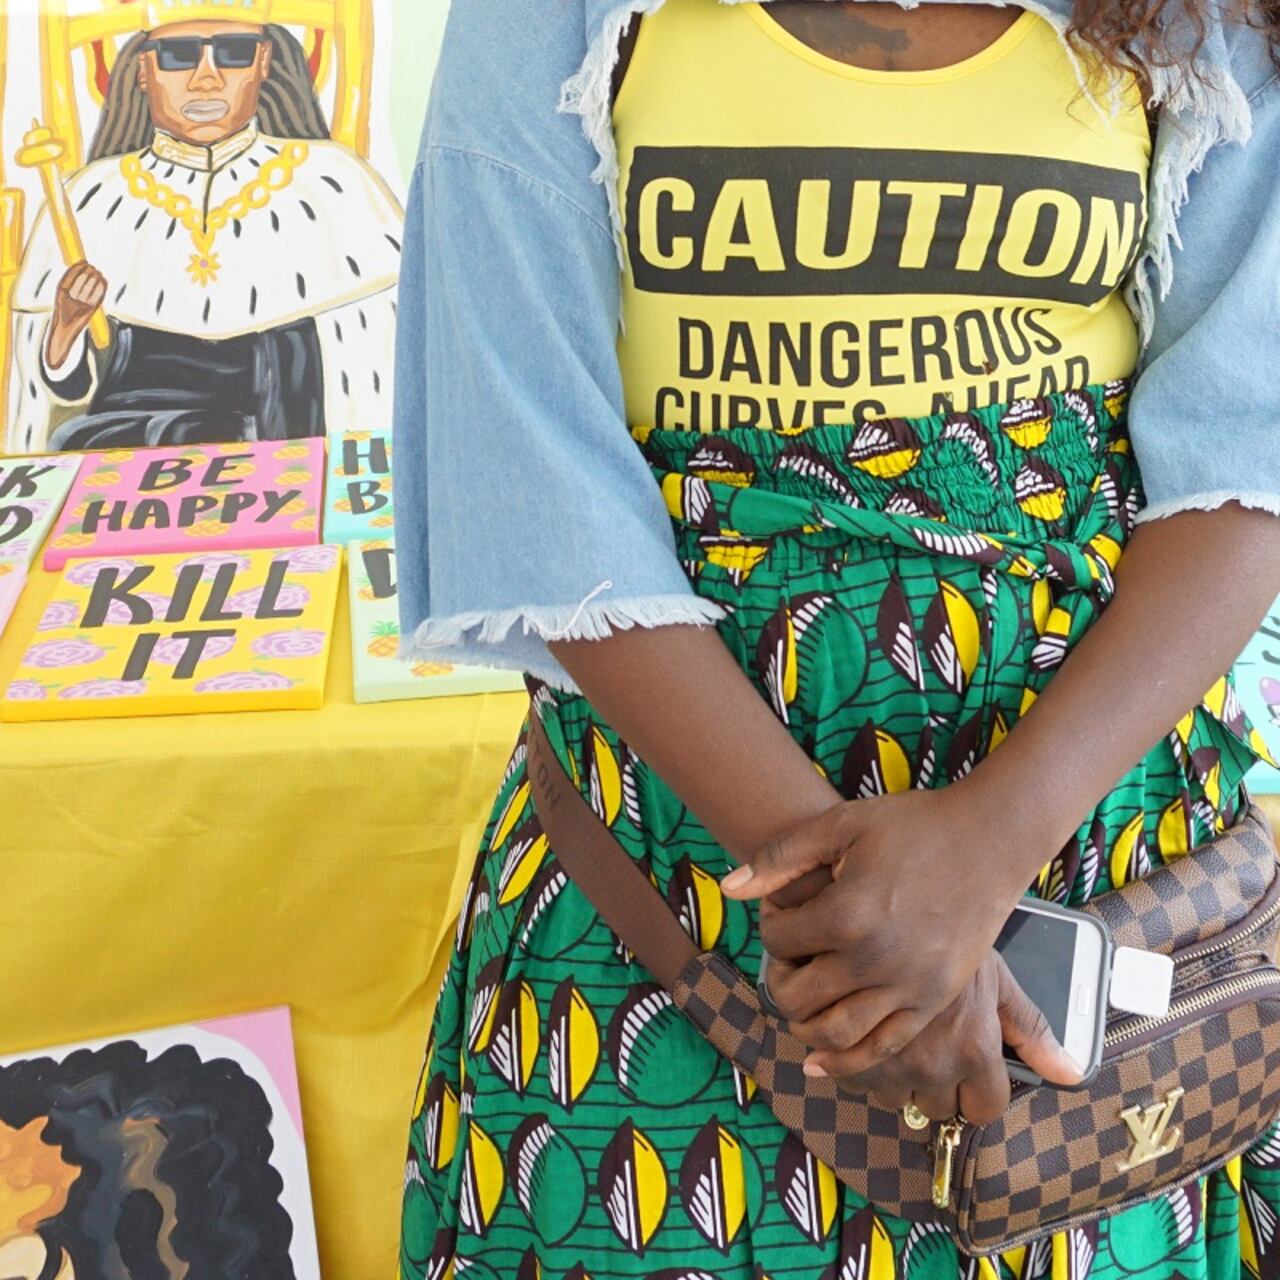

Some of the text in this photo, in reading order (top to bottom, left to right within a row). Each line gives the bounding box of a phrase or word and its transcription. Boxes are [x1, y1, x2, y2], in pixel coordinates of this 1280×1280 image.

[637, 176, 1137, 287] CAUTION
[677, 306, 1063, 388] DANGEROUS
[136, 451, 254, 493] BE
[81, 489, 302, 534] HAPPY
[79, 559, 307, 628] KILL
[120, 627, 237, 682] IT
